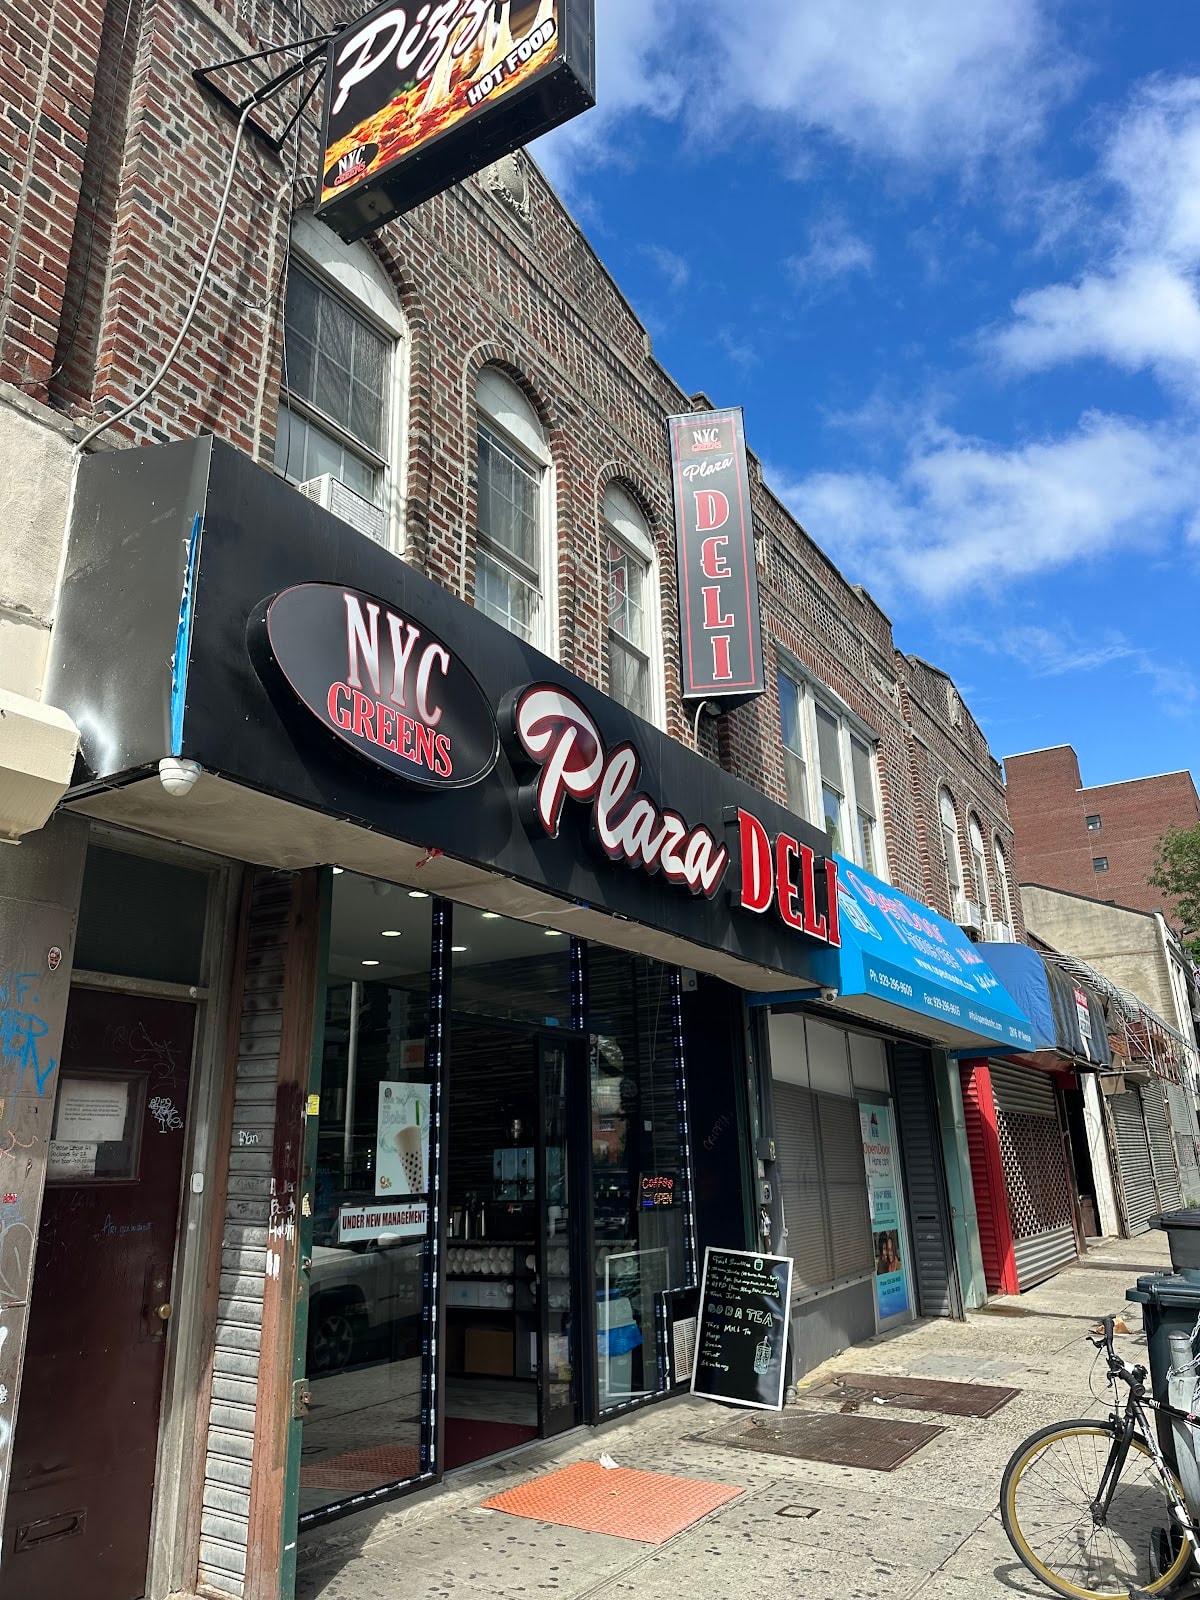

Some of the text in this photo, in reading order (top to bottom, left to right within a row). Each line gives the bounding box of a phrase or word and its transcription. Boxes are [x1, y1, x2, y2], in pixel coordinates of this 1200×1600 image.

[332, 0, 509, 116] Pizz
[466, 18, 557, 107] HOT FOOD
[337, 146, 366, 176] NYC
[692, 428, 720, 445] NYC
[683, 457, 733, 482] Plaza
[693, 489, 735, 680] DELI
[343, 592, 451, 727] NYC
[327, 681, 453, 778] GREENS
[516, 685, 842, 949] Plaza DELI
[342, 1209, 426, 1230] UNDER NEW MANAGEMENT
[653, 1192, 673, 1205] OPEN
[708, 1303, 774, 1328] BOBA TEA
